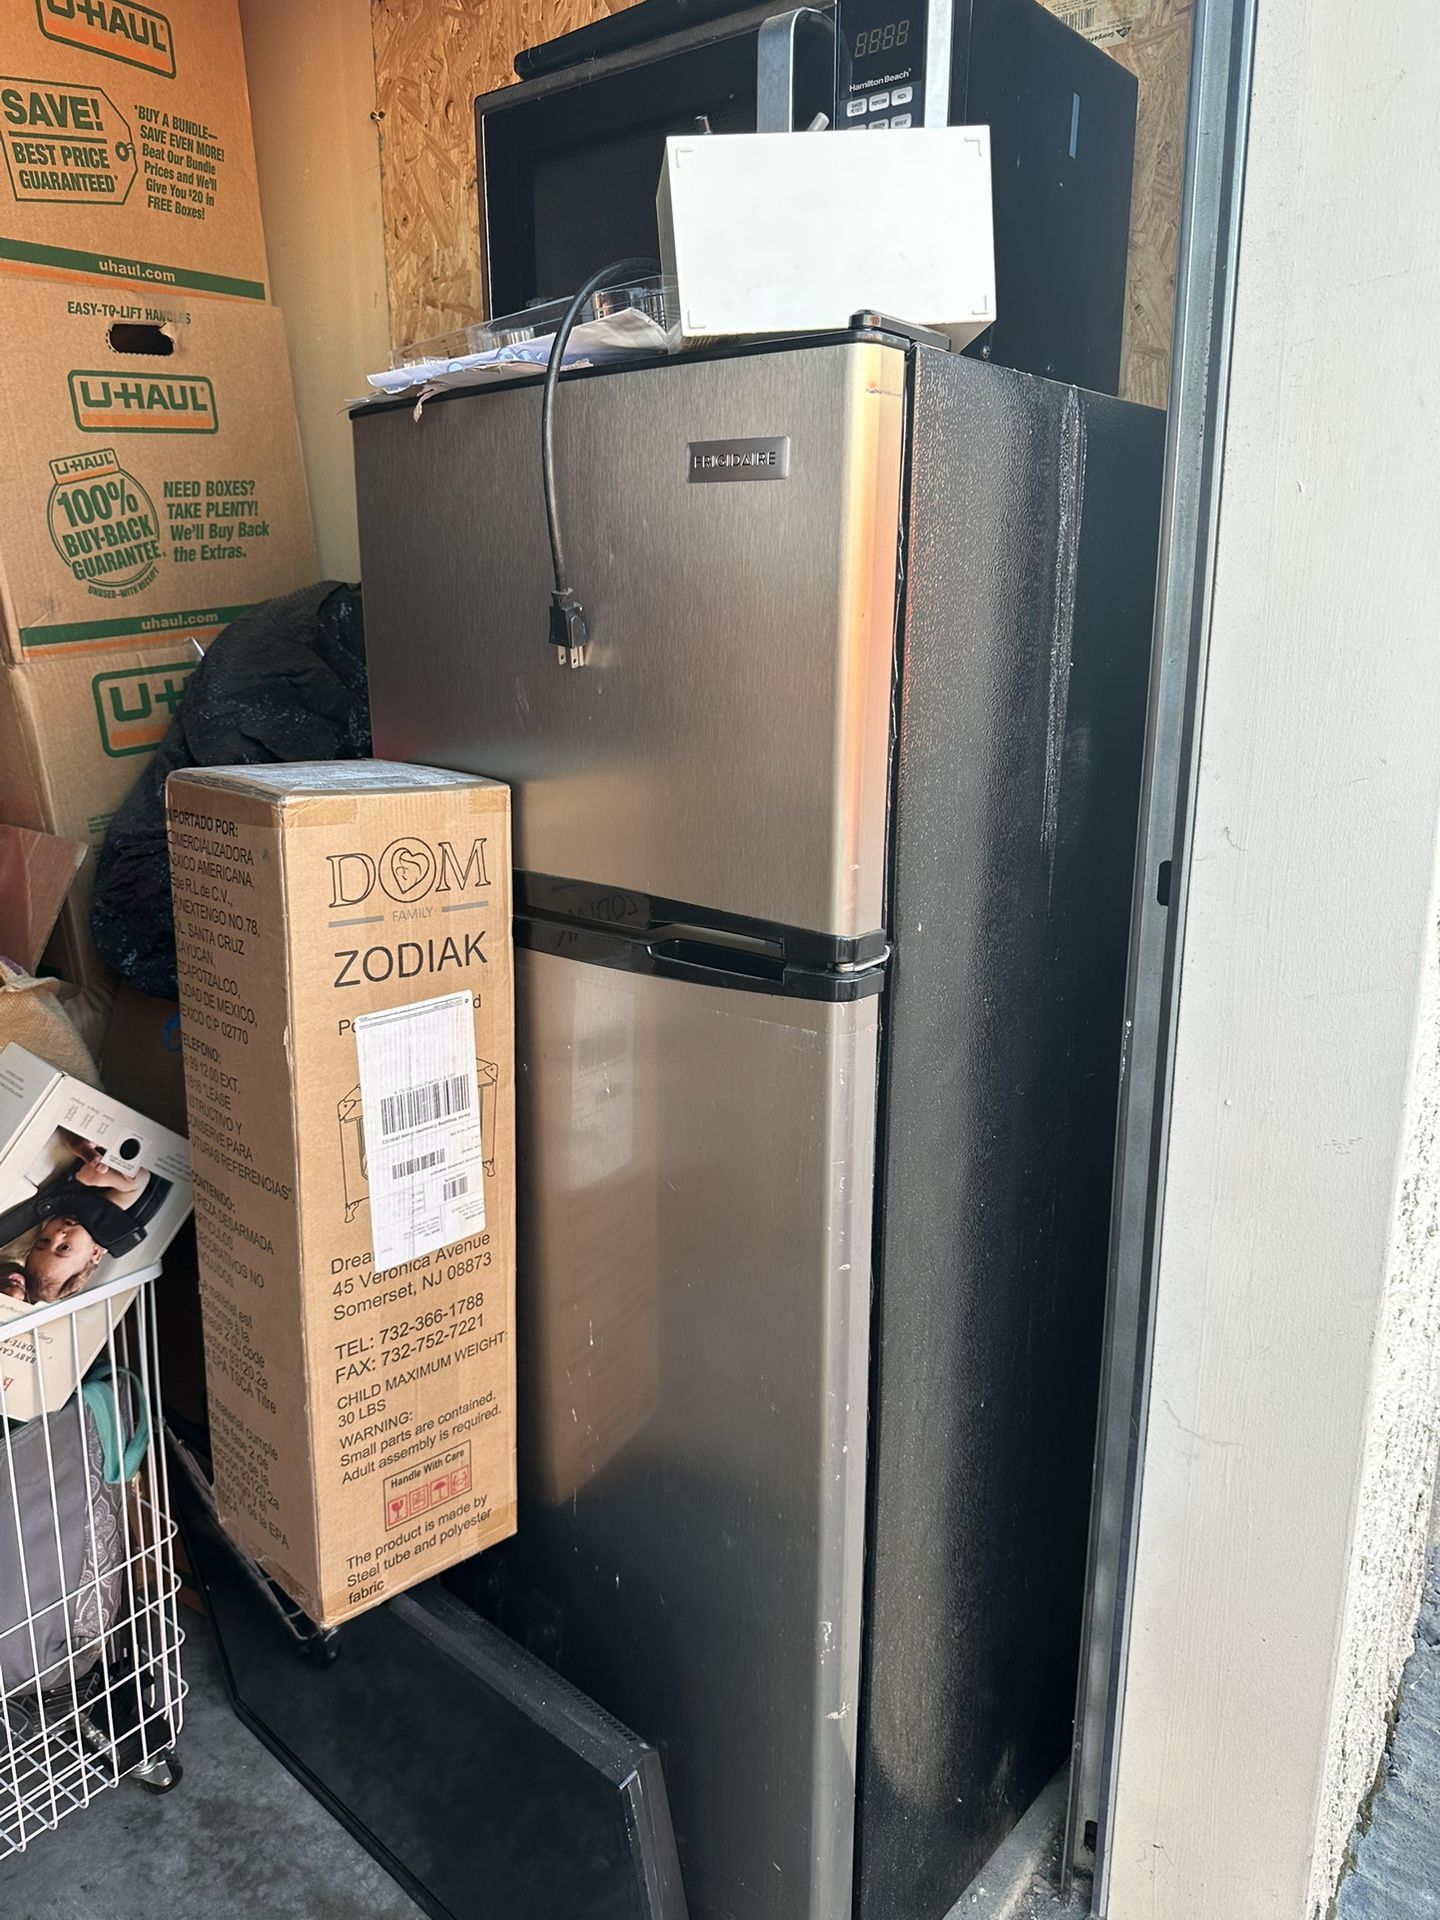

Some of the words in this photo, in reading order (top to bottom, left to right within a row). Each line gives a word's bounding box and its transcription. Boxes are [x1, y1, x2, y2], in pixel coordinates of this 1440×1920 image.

[849, 77, 884, 92] Hamilton
[1, 89, 104, 131] SAVE!
[162, 112, 170, 127] A
[14, 142, 57, 165] BEST
[63, 146, 110, 168] PRICE
[140, 125, 167, 147] SAVE
[169, 131, 194, 152] EVEN
[196, 138, 225, 163] MORE!
[142, 144, 165, 162] Beat
[167, 149, 184, 166] Our
[186, 154, 216, 176] Bundle
[144, 160, 175, 181] Prices
[177, 167, 194, 186] and
[196, 173, 217, 192] We'll
[146, 178, 167, 197] Give
[169, 183, 187, 200] You
[188, 188, 203, 204] $20
[206, 193, 215, 207] in
[147, 195, 172, 213] FREE
[175, 200, 205, 220] Boxes!
[99, 259, 176, 283] uhaul.com
[67, 301, 142, 320] EASY-TO-LIFT
[80, 380, 208, 412] U-HAUL
[54, 452, 114, 476] U-HAUL
[694, 451, 776, 468] FRIGIDAIRE
[57, 478, 139, 528] 100%
[163, 481, 200, 498] NEED
[206, 480, 255, 497] BOXES?
[167, 502, 201, 519] TAKE
[206, 501, 258, 518] PLENTY!
[62, 515, 154, 558] BUY-BACK
[170, 523, 204, 541] We'll
[209, 523, 234, 542] Buy
[238, 521, 270, 537] Back
[173, 546, 196, 562] the
[201, 544, 247, 560] Extras.
[141, 612, 219, 631] uhaul.com
[215, 819, 239, 838] POR:
[392, 907, 434, 922] FAMILY
[188, 923, 216, 946] SANTA
[217, 933, 245, 955] CRUZ
[333, 931, 487, 988] ZODIAK
[204, 991, 216, 1009] DE
[217, 997, 258, 1028] MEXICO,
[221, 1021, 249, 1045] 02770
[235, 1121, 242, 1135] Y
[226, 1137, 254, 1162] PARA
[331, 1252, 374, 1275] Drea
[332, 1278, 354, 1297] 45
[359, 1257, 430, 1289] Veronica
[435, 1234, 490, 1263] Avenue
[333, 1282, 417, 1320] Somerset,
[422, 1269, 443, 1290] NJ
[447, 1251, 493, 1280] 08873
[335, 1336, 374, 1360] TEL:
[379, 1292, 484, 1345] 732-366-1788
[335, 1358, 377, 1384] FAX:
[381, 1313, 484, 1367] 732-752-7221
[337, 1383, 381, 1410] CHILD
[385, 1355, 451, 1392] MAXIMUM
[454, 1330, 509, 1363] WEIGHT:
[338, 1411, 355, 1428] 30
[359, 1399, 386, 1420] LBS
[339, 1411, 413, 1450] WARNING:
[340, 1443, 377, 1468] Small
[380, 1431, 412, 1454] parts
[415, 1420, 434, 1435] are
[437, 1390, 496, 1424] contained.
[341, 1461, 376, 1486] Adult
[379, 1435, 436, 1468] assembly
[439, 1427, 449, 1441] is
[452, 1403, 502, 1436] required.
[390, 1468, 422, 1490] Handle
[423, 1459, 444, 1475] With
[445, 1449, 465, 1465] Care
[346, 1550, 372, 1570] The
[376, 1525, 422, 1557] product
[425, 1520, 435, 1534] is
[438, 1503, 471, 1526] made
[474, 1493, 488, 1510] by
[347, 1564, 380, 1588] Steel
[384, 1548, 411, 1570] tube
[414, 1535, 437, 1555] and
[440, 1507, 493, 1544] polyester
[348, 1579, 385, 1605] fabric
